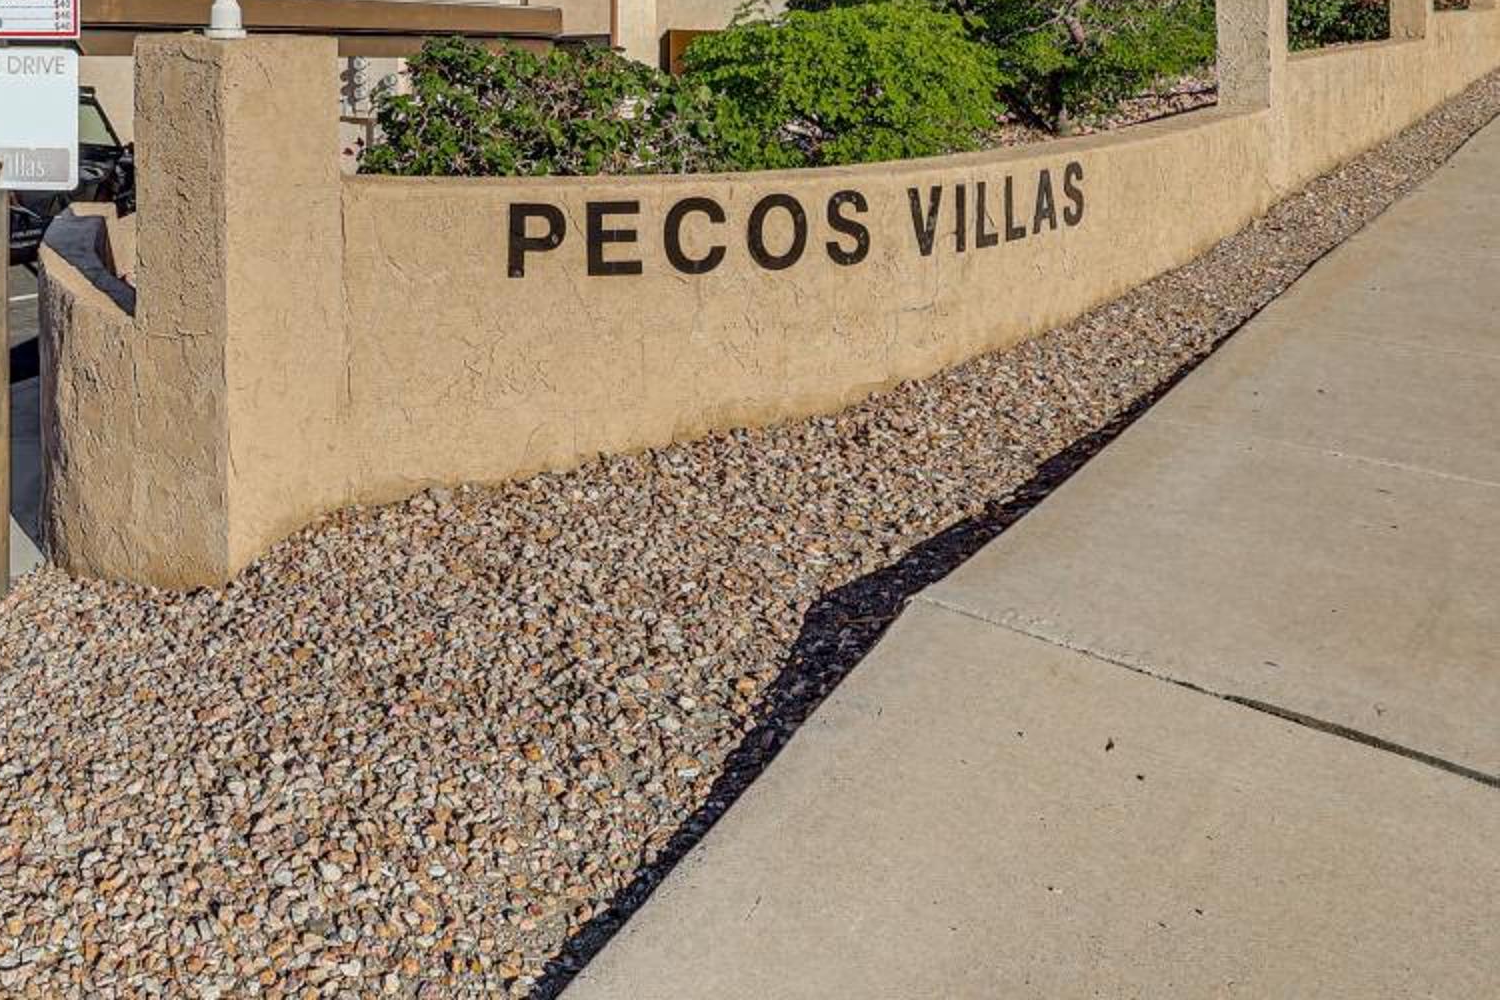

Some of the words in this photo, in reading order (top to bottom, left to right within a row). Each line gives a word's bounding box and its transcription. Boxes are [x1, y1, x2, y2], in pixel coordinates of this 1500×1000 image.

[7, 55, 66, 75] DRIVE
[507, 189, 871, 278] PECOS
[907, 161, 1085, 257] VILLAS
